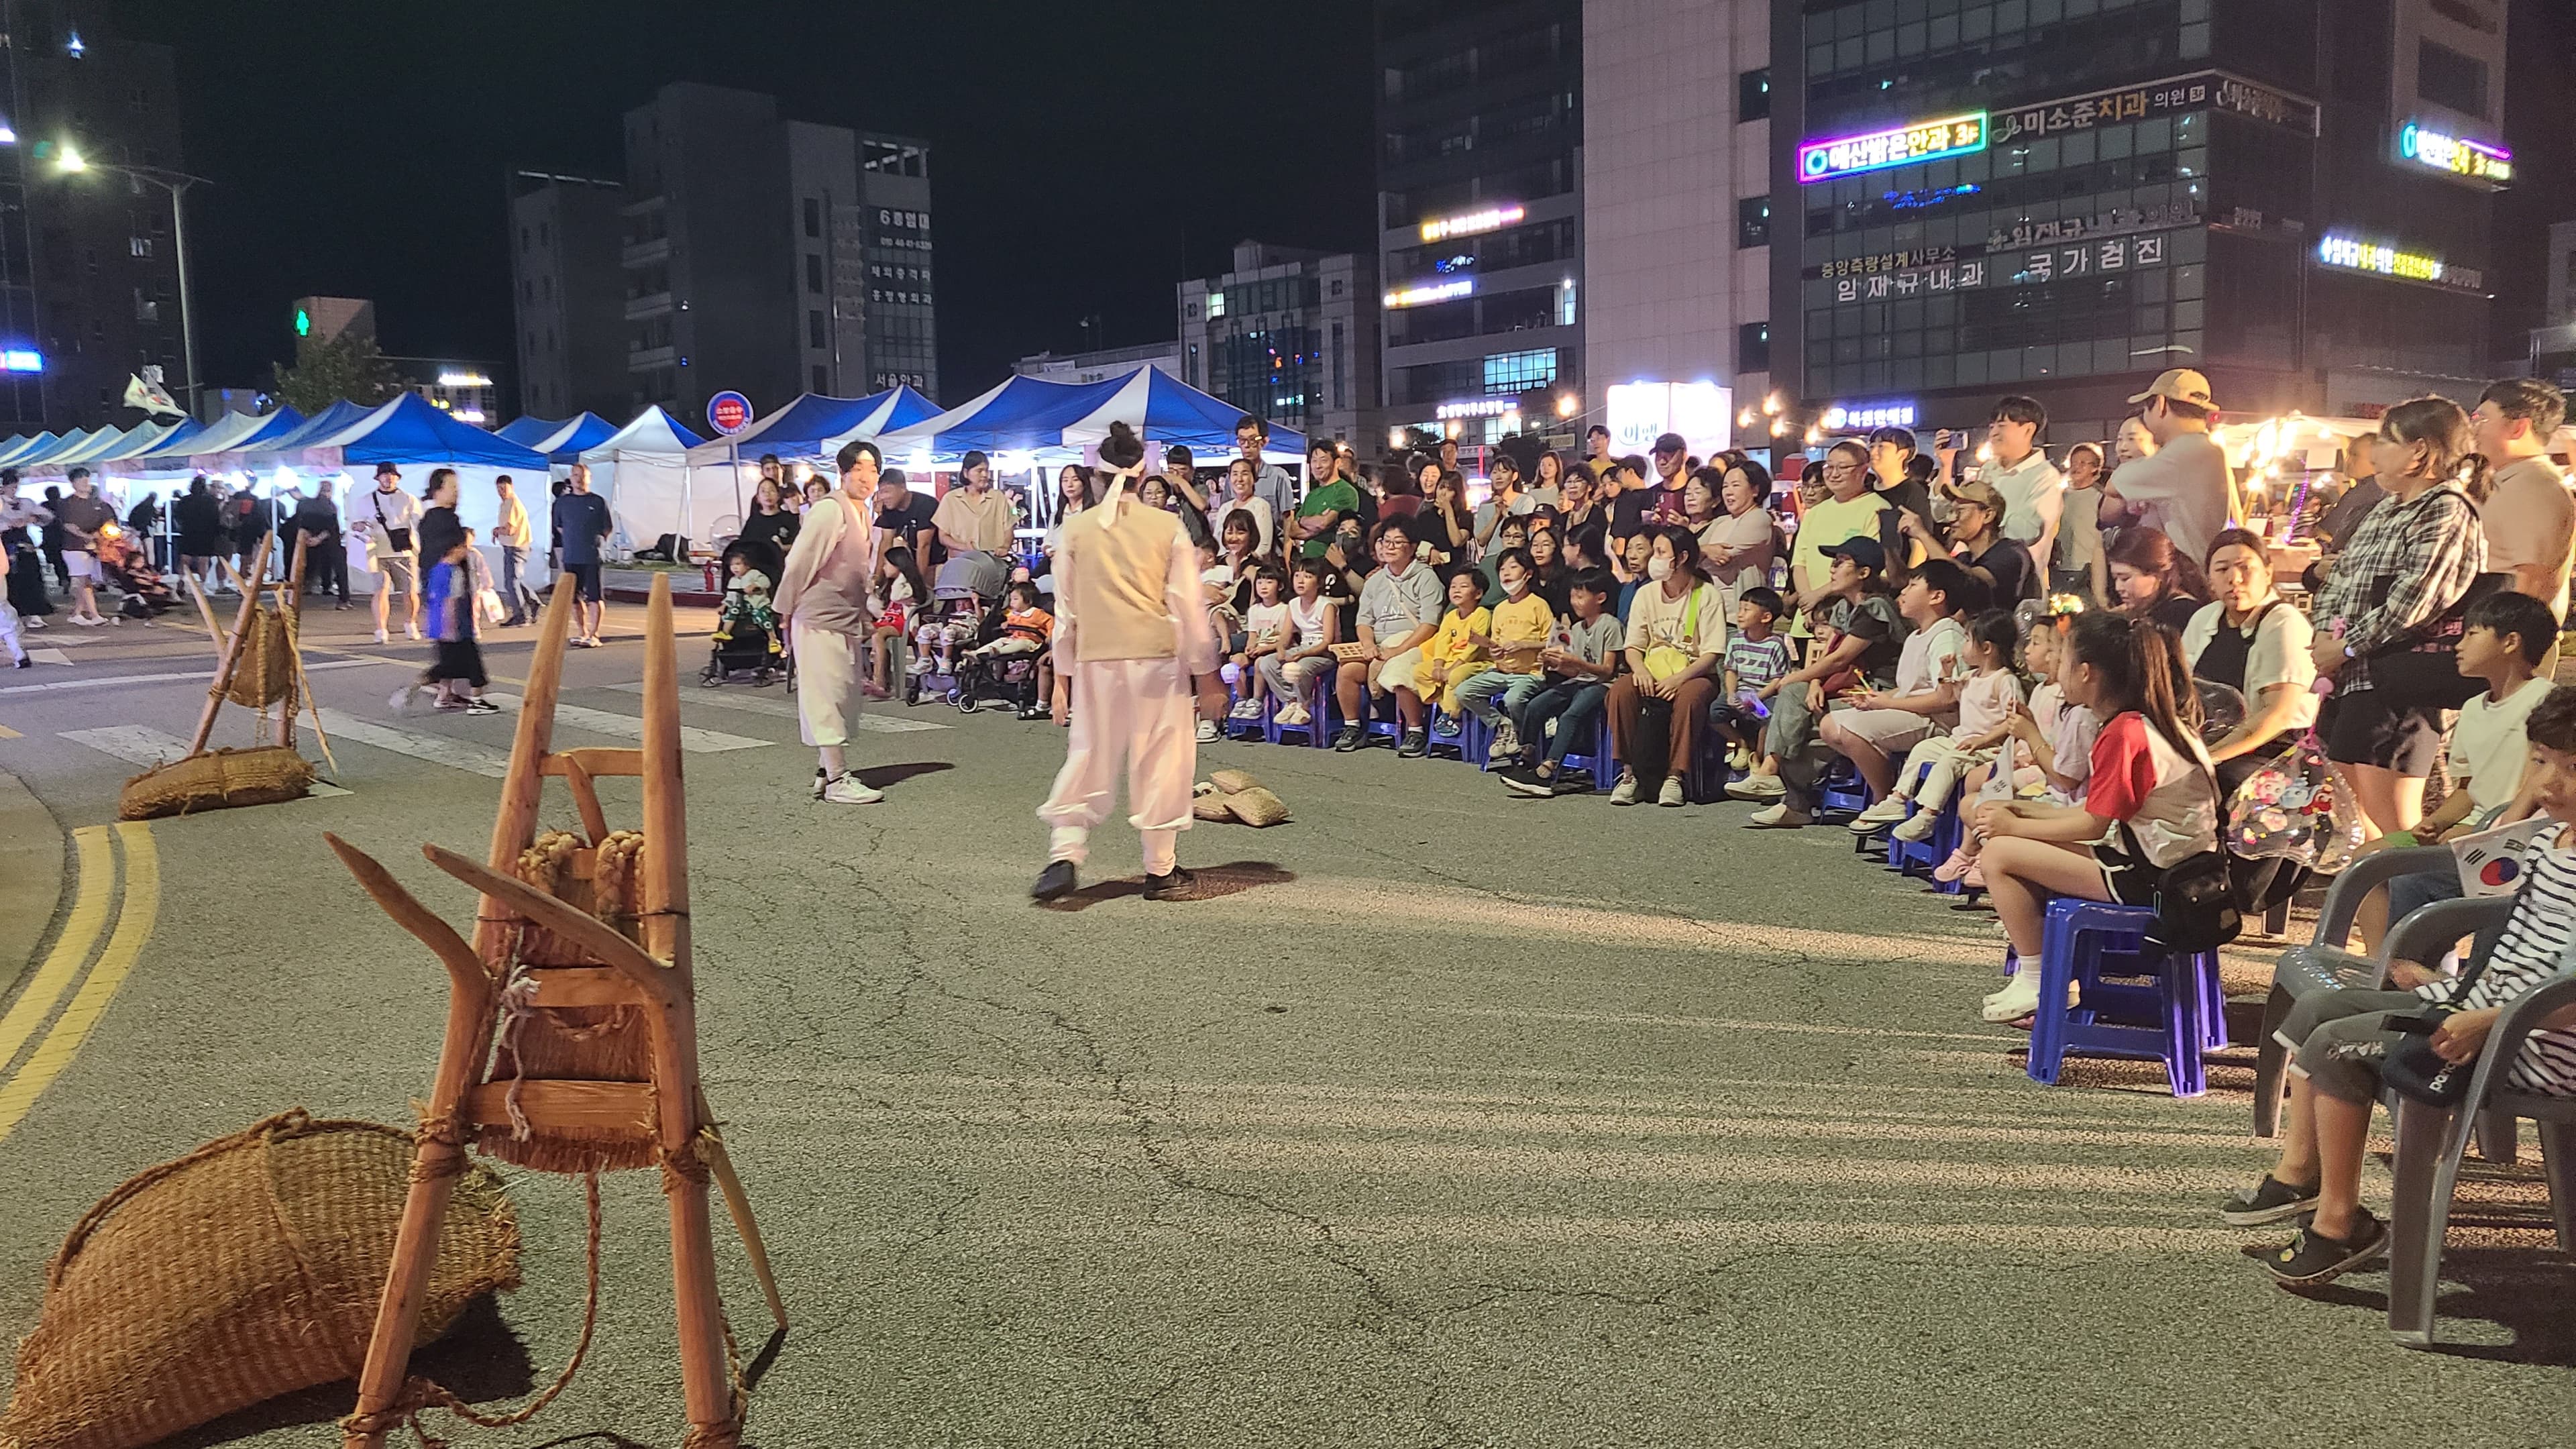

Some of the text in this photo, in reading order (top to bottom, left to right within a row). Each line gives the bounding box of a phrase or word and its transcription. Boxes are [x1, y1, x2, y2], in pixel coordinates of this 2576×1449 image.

[2024, 90, 2149, 136] 미소준치과
[2154, 89, 2185, 107] 의원
[1954, 123, 1979, 146] 3F
[1821, 244, 1956, 278] 중앙측량설계사무소
[1837, 236, 2162, 302] 임재규내과 국가검진
